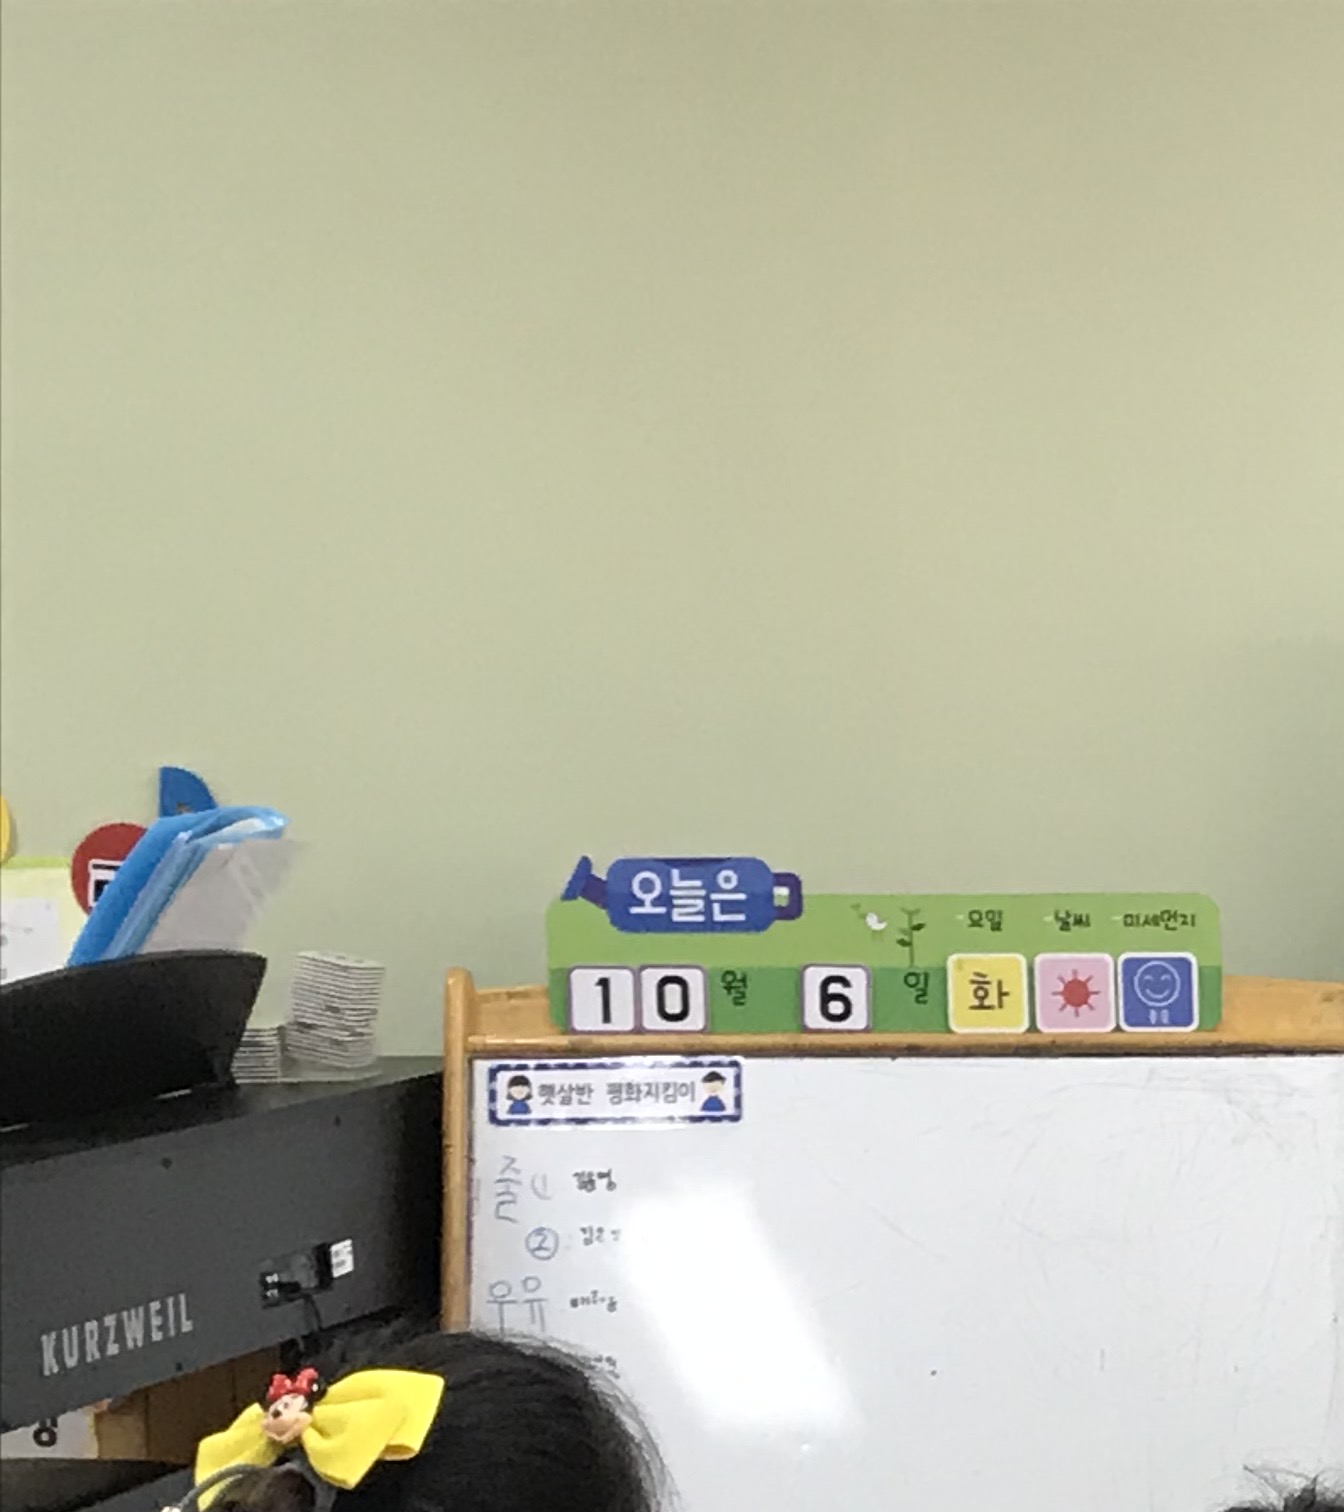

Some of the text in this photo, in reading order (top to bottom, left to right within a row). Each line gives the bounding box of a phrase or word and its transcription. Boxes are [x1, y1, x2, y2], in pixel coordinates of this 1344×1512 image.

[628, 868, 748, 923] 오늘은
[967, 908, 1196, 932] 요일 날씨 미세먼지
[595, 969, 1011, 1024] 10 월 6 일 화
[605, 1080, 697, 1105] 평화지킴이
[486, 1275, 548, 1338] 우유
[41, 1292, 194, 1377] KURZWEIL
